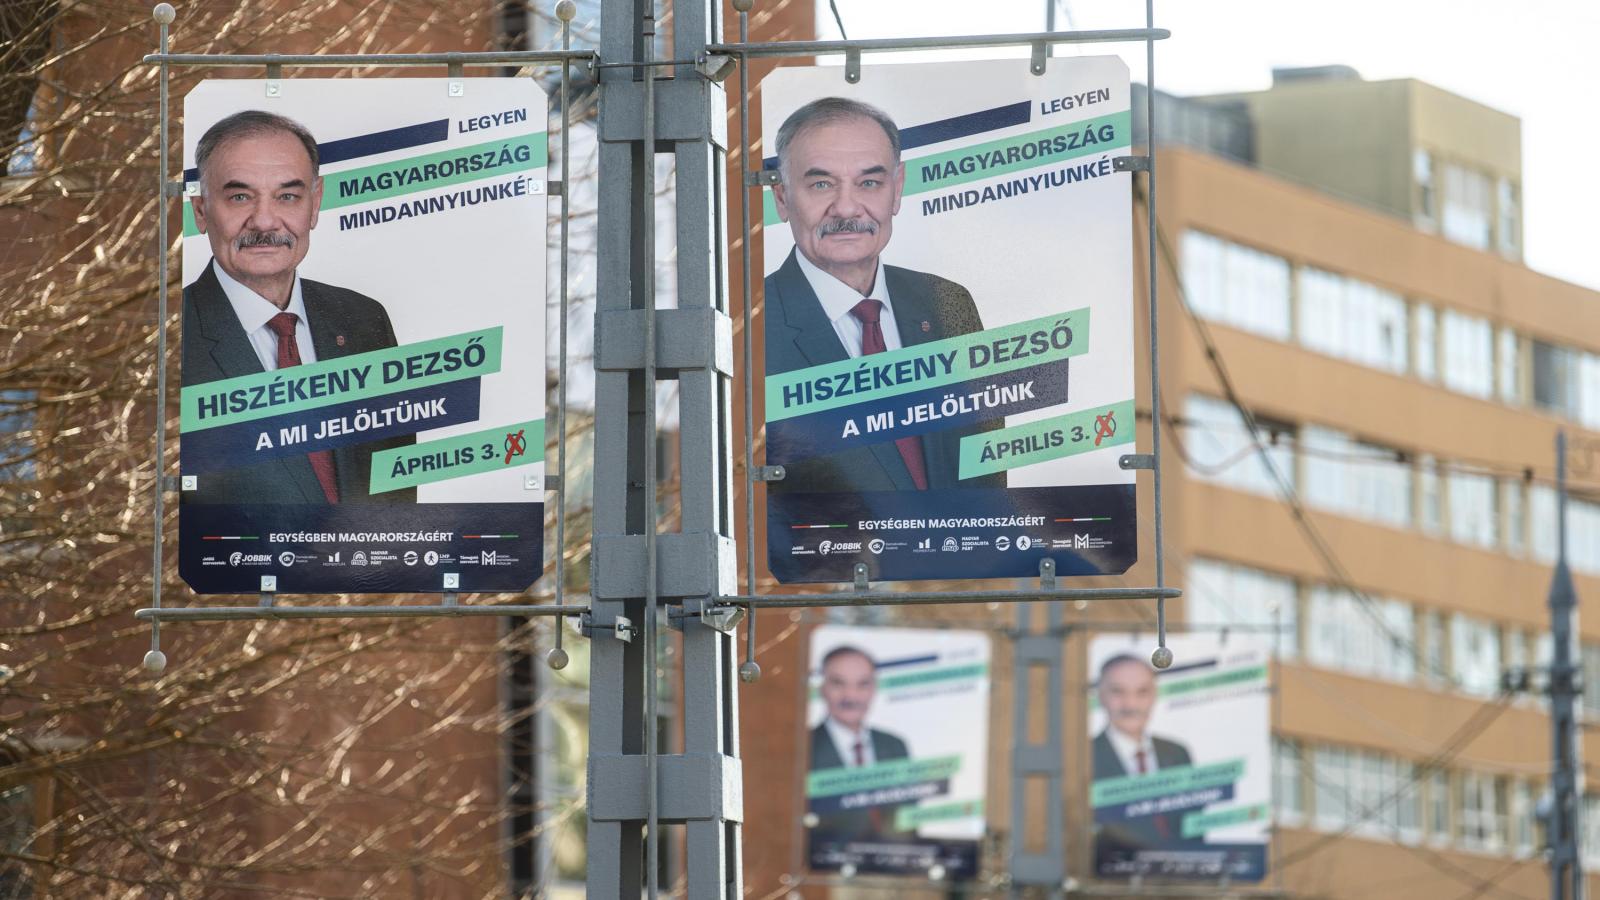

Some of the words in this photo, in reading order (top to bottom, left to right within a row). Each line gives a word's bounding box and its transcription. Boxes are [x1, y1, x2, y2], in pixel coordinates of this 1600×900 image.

[1041, 88, 1110, 114] LEGYEN
[458, 108, 527, 133] LEGYEN
[339, 144, 530, 198] MAGYARORSZÁG
[921, 124, 1115, 183] MAGYARORSZÁG
[339, 175, 532, 231] MINDANNYIUNKÉ
[198, 364, 372, 419] HISZÉKENY
[383, 335, 486, 385] DEZSŐ
[782, 351, 958, 408] HISZÉKENY
[969, 317, 1073, 369] DEZSŐ
[255, 431, 273, 451] A
[280, 424, 307, 446] MI
[314, 397, 447, 440] JELÖLTÜNK
[842, 418, 860, 438] A
[866, 411, 894, 433] MI
[901, 381, 1035, 427] JELÖLTÜNK
[391, 444, 474, 478] ÁPRILIS
[481, 444, 501, 460] 3.
[980, 428, 1064, 463] ÁPRILIS
[1071, 426, 1090, 443] 3.
[269, 531, 336, 544] EGYSÉGBEN
[339, 529, 454, 543] MAGYARORSZÁGÉRT
[858, 518, 926, 531] EGYSÉGBEN
[928, 515, 1046, 529] MAGYARORSZÁGÉRT
[241, 554, 273, 562] JOBBIK
[831, 542, 861, 550] JOBBIK
